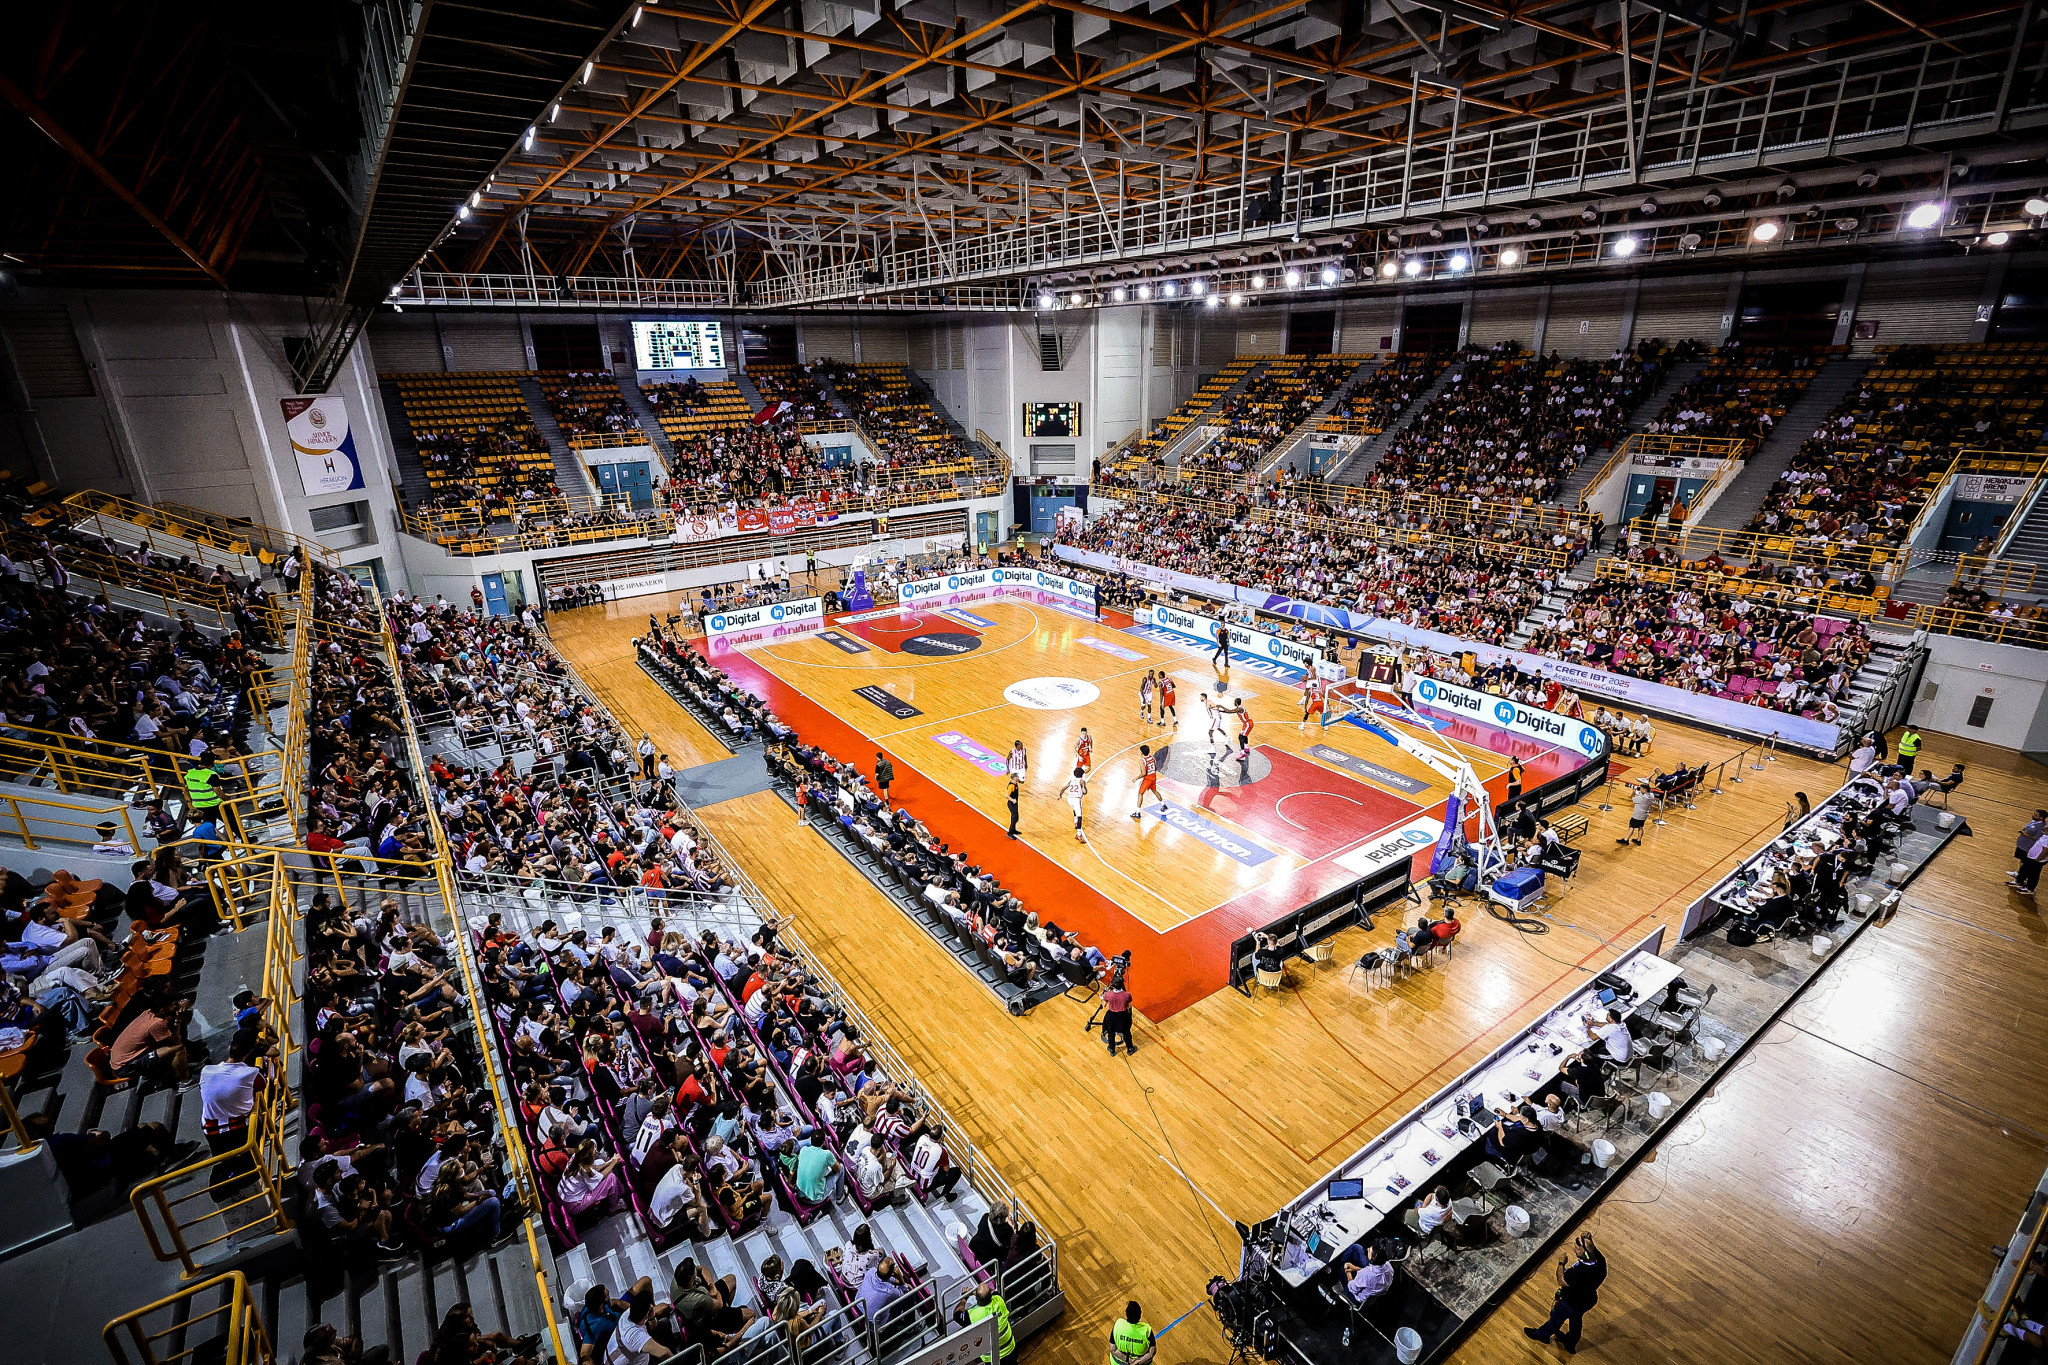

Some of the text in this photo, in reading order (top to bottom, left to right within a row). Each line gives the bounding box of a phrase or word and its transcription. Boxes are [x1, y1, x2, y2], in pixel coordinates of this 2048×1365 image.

[626, 578, 664, 589] ΗΡΑΚΛΕΙΟΥ
[960, 573, 985, 588] Digital
[1004, 570, 1032, 583] Digital
[1045, 575, 1063, 590] Digital
[915, 580, 941, 594] Digital
[1078, 585, 1096, 598] Digita
[785, 602, 817, 616] Digital
[727, 611, 760, 627] Digital
[1168, 611, 1195, 629] Digital
[1229, 629, 1251, 645] igital
[1372, 653, 1396, 666] 7:39
[1370, 665, 1390, 680] 17
[1555, 665, 1631, 689] CRETE IBT 2025
[1438, 687, 1482, 712] Digital
[1516, 710, 1566, 737] Digital
[1069, 784, 1079, 793] 22
[1364, 838, 1416, 864] Digital
[790, 1062, 799, 1075] 7
[636, 1128, 653, 1153] 11
[914, 1146, 930, 1170] 10
